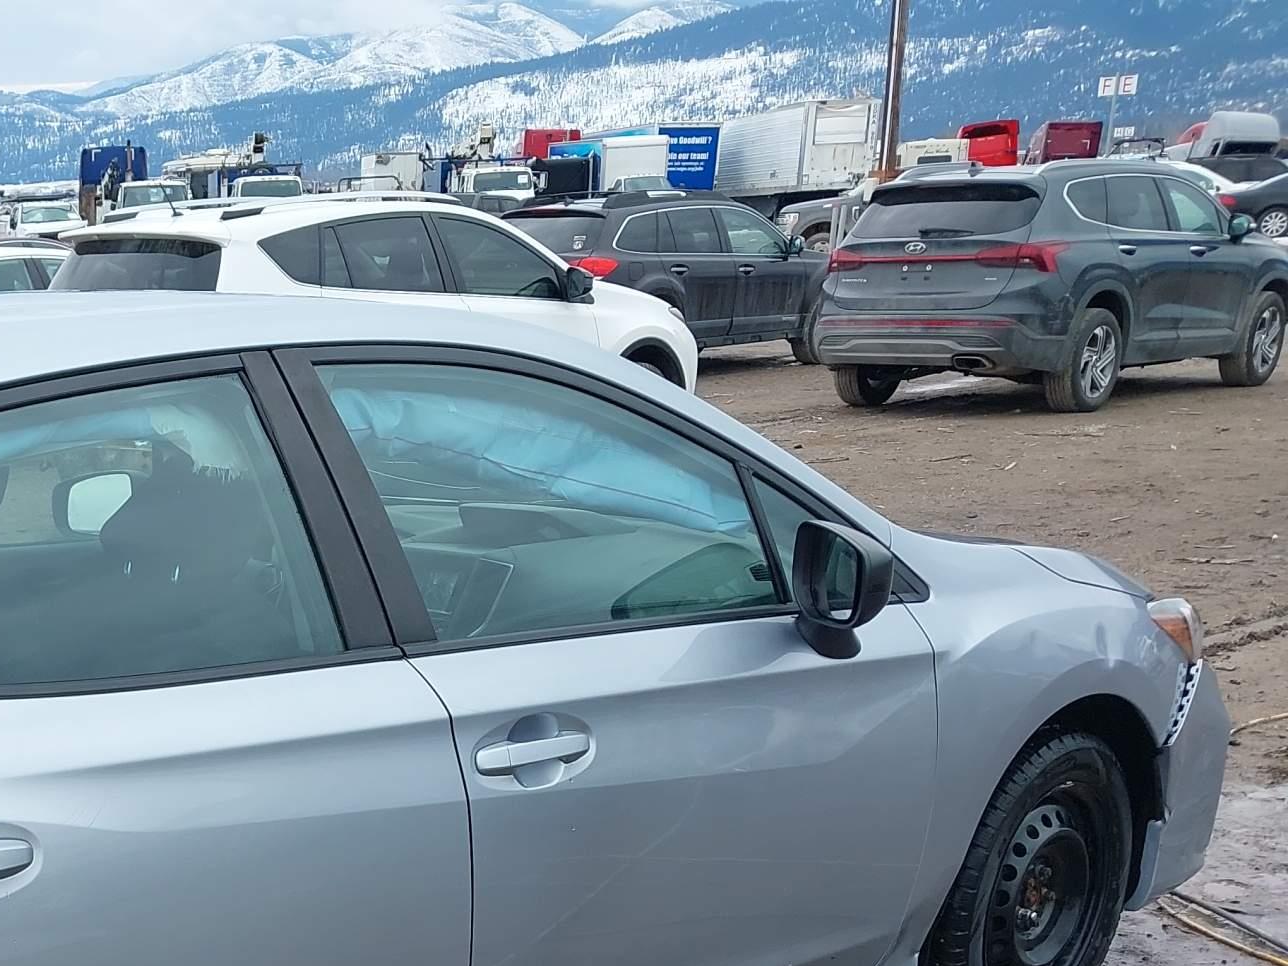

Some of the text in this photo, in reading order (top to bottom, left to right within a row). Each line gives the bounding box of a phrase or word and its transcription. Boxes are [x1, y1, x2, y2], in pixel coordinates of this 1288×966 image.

[1103, 78, 1113, 95] F
[1123, 77, 1134, 92] E
[679, 136, 707, 144] Goodwill
[690, 152, 709, 160] team!
